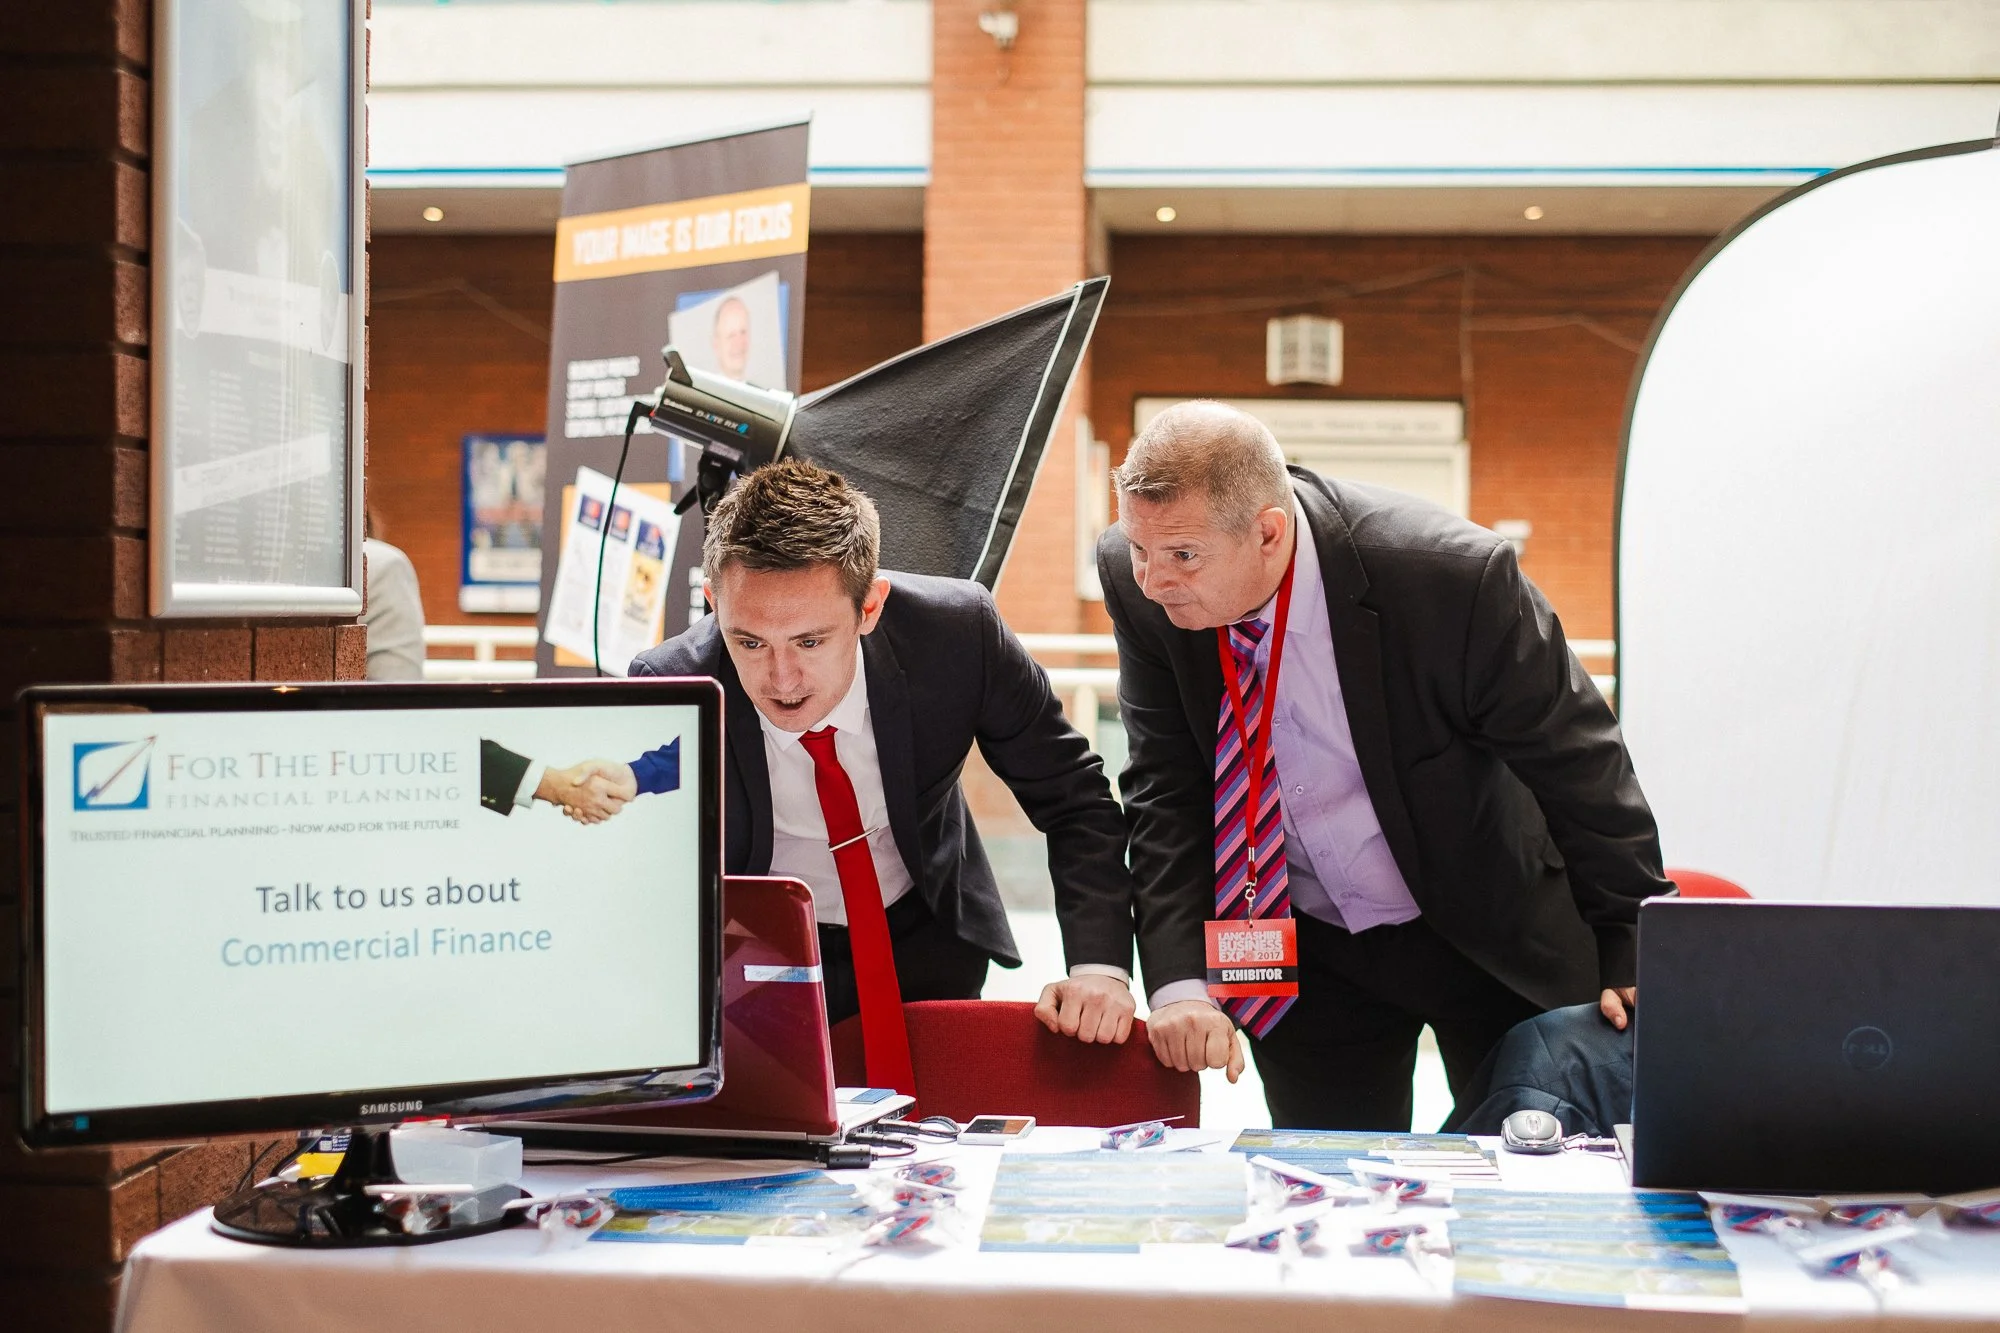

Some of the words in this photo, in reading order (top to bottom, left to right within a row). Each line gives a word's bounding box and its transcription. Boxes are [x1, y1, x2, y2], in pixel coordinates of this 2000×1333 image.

[573, 228, 618, 264] YOUR
[621, 220, 672, 260] IMAGE
[674, 217, 693, 252] IS
[695, 210, 732, 250] OUR
[734, 202, 793, 244] FOCUS
[167, 754, 240, 780] FOR
[249, 752, 319, 778] THE
[330, 750, 458, 776] FUTURE
[166, 791, 315, 809] FINANCIAL
[326, 786, 461, 804] PLANNING
[71, 829, 131, 842] TRUSTED
[134, 826, 206, 840] FINANCIAL
[209, 824, 280, 837] PLANNING
[289, 823, 324, 834] NOW
[326, 822, 356, 833] AND
[359, 821, 384, 832] FOR
[386, 820, 410, 831] THE
[413, 819, 461, 830] FUTURE
[256, 883, 322, 913] Talk
[333, 885, 366, 910] to
[380, 886, 414, 908] us
[426, 877, 521, 906] about
[1218, 930, 1282, 941] LANCASHIRE
[1218, 940, 1282, 951] BUSINESS
[222, 928, 419, 967] Commercial
[431, 928, 552, 955] Finance
[1257, 952, 1280, 960] 2017
[1222, 968, 1283, 981] EXHIBITOR
[360, 1100, 423, 1115] SAMSUNG
